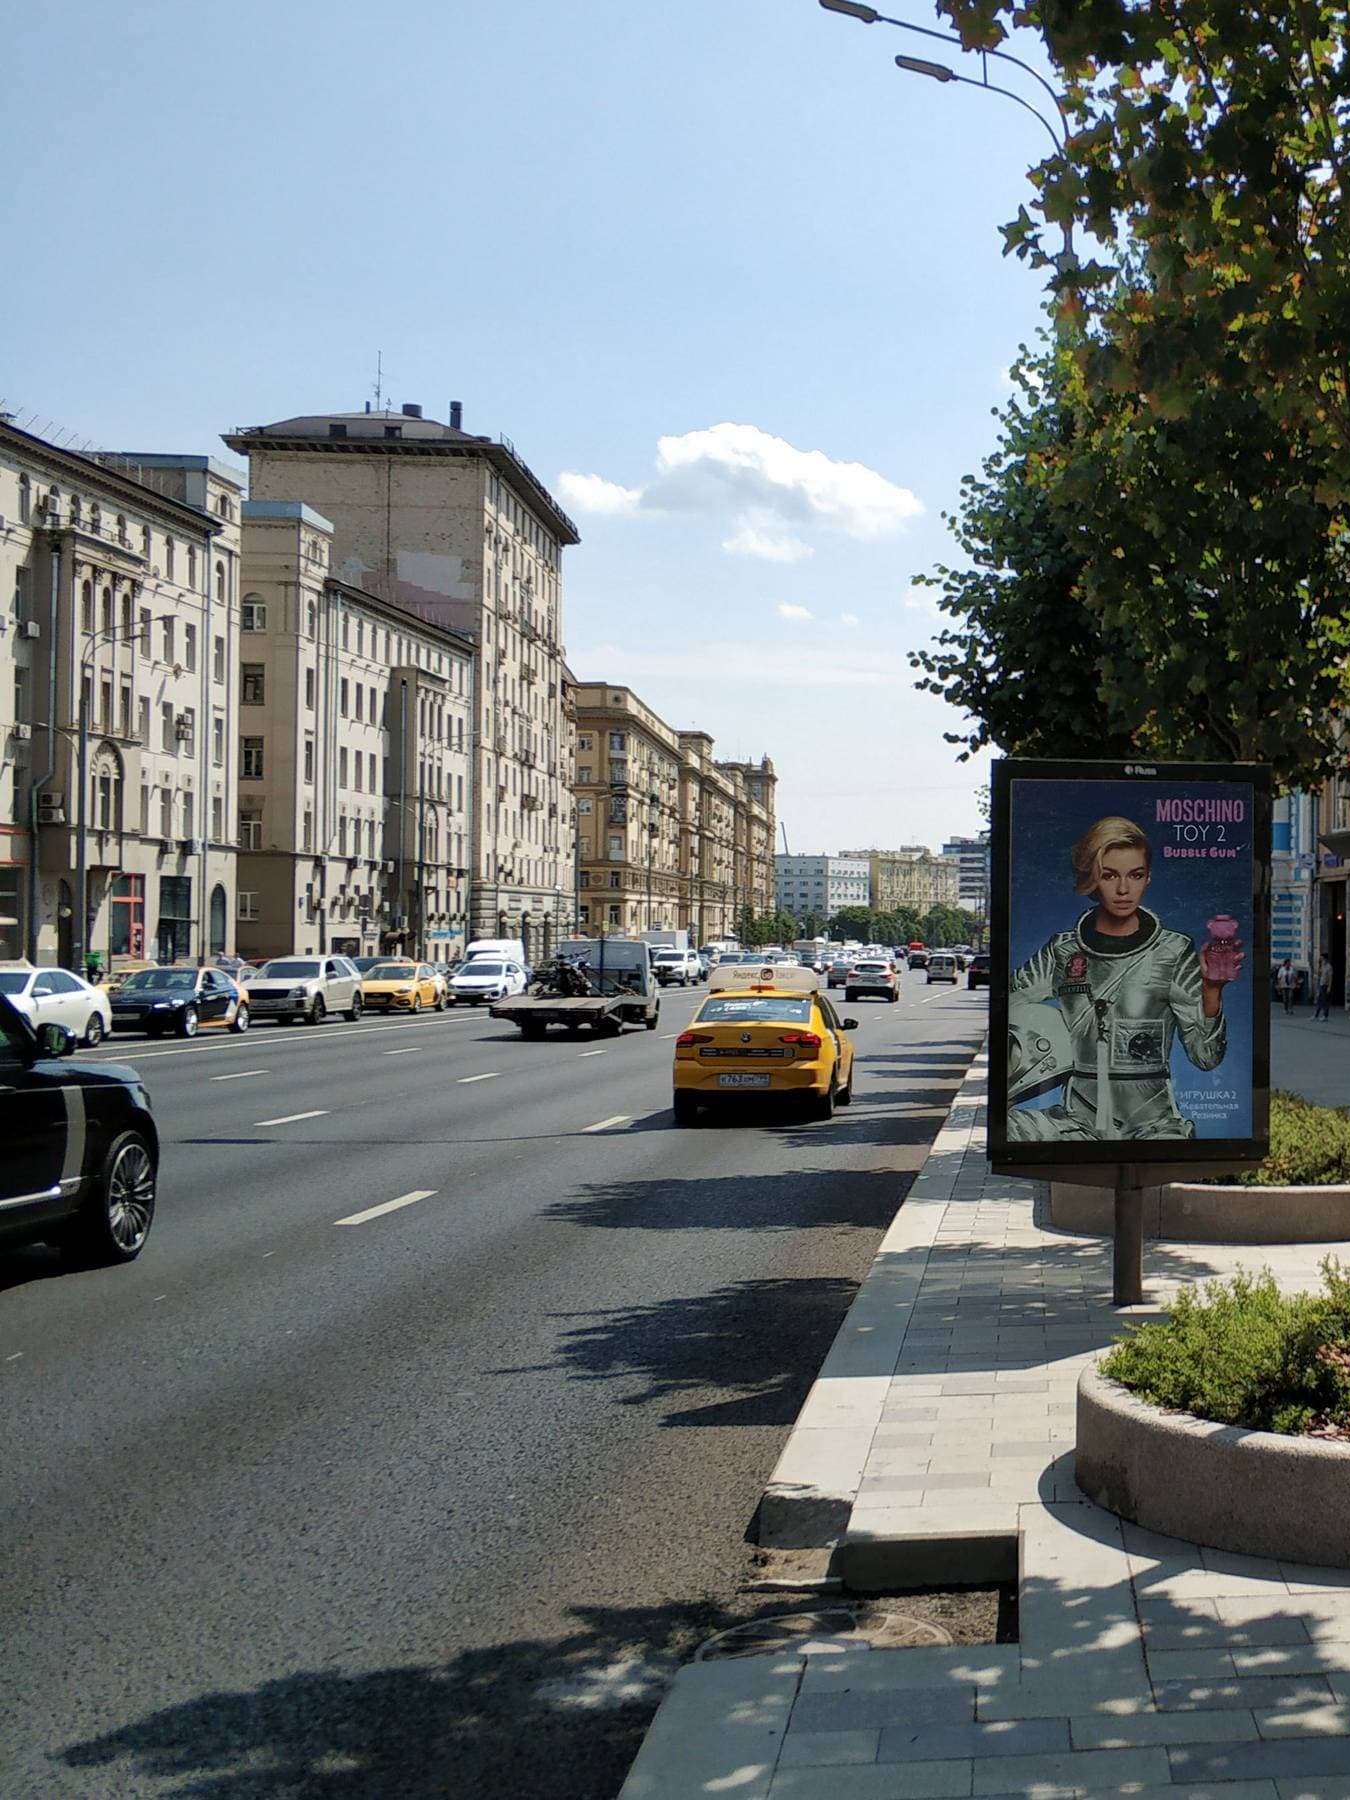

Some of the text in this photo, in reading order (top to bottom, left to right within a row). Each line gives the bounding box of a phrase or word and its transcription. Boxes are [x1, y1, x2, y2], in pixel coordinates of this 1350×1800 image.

[1155, 799, 1245, 823] MOSCHINO
[1172, 824, 1227, 842] TOY 2
[1163, 846, 1208, 858] BUBBLE
[1179, 1090, 1237, 1100] ИГРУШКА 2
[1179, 1101, 1239, 1111] Жевательная
[1191, 1110, 1228, 1120] Резинка
